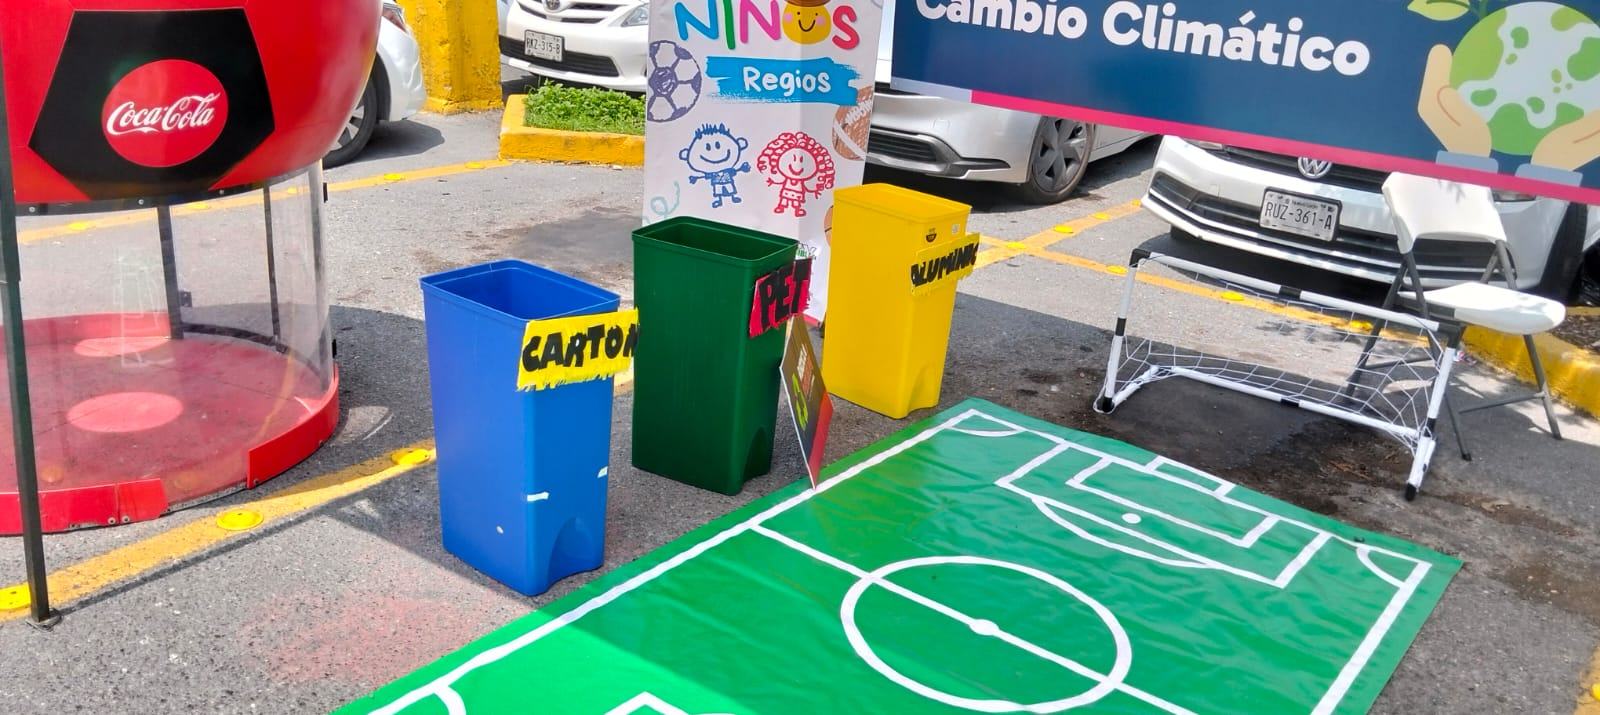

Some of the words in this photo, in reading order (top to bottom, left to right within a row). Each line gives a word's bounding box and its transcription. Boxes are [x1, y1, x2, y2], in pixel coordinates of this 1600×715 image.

[1102, 0, 1371, 77] Climático
[742, 66, 832, 97] Regios
[107, 92, 220, 135] Coca-Cola
[1264, 202, 1333, 230] RUZ-361-A
[760, 259, 813, 328] PET
[522, 323, 638, 372] CARTON
